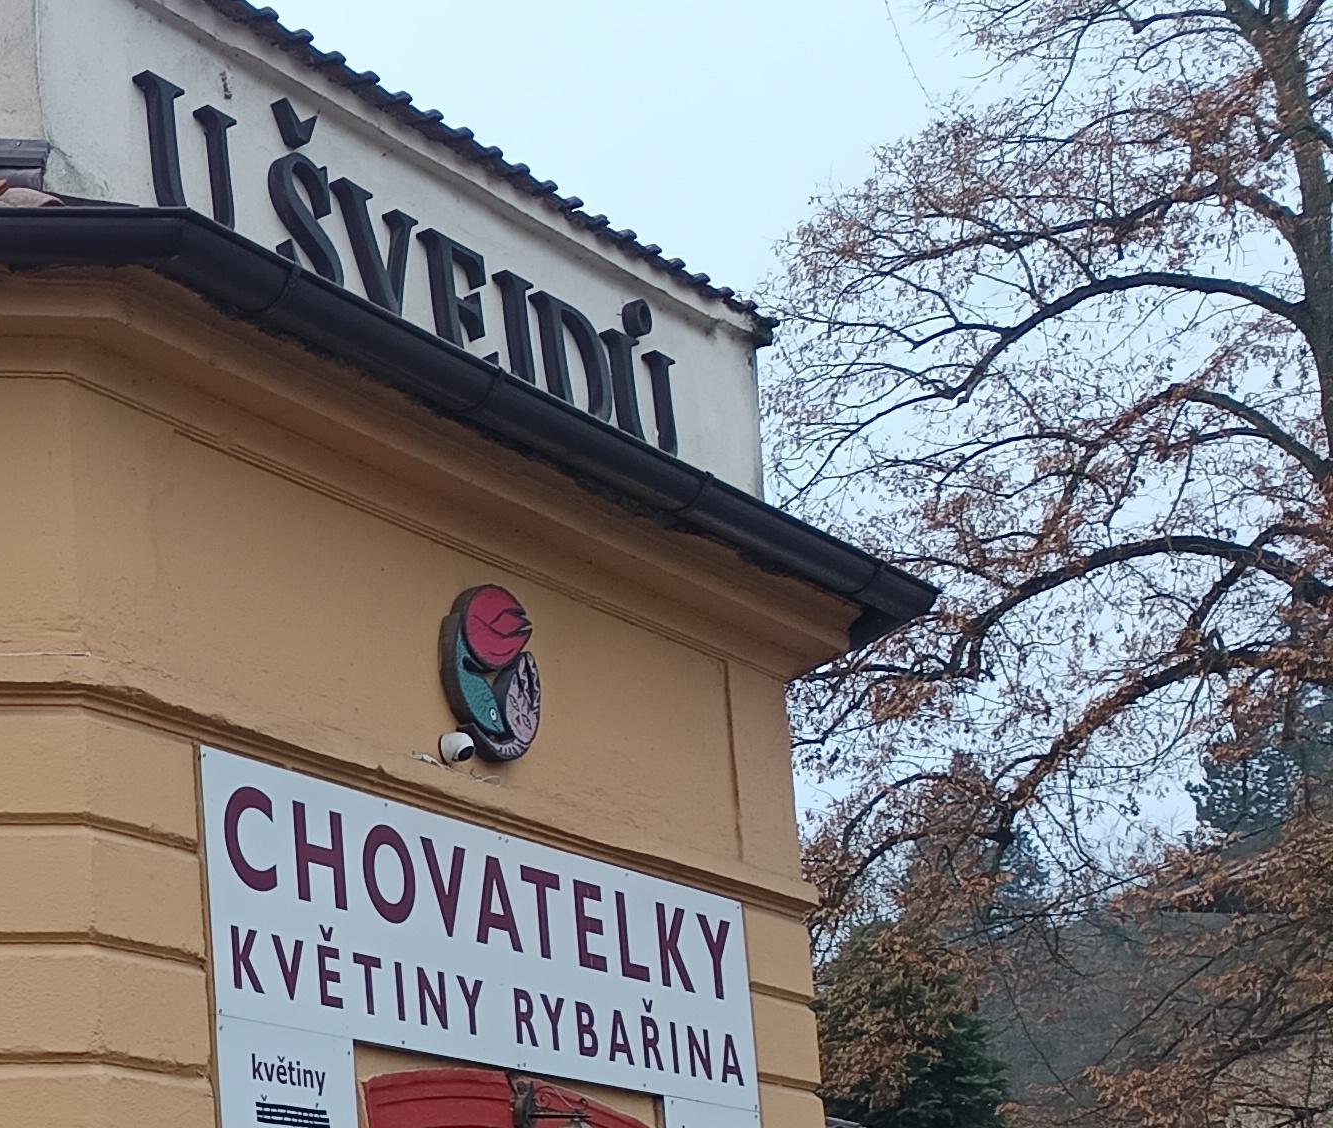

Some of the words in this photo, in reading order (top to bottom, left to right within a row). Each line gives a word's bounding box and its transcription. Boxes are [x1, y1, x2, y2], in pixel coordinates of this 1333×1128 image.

[133, 70, 236, 229] U
[224, 786, 730, 999] CHOVATELKY
[230, 924, 482, 1035] KVĚTINY
[514, 998, 744, 1086] RYBAŘINA
[251, 1053, 326, 1096] květiny
